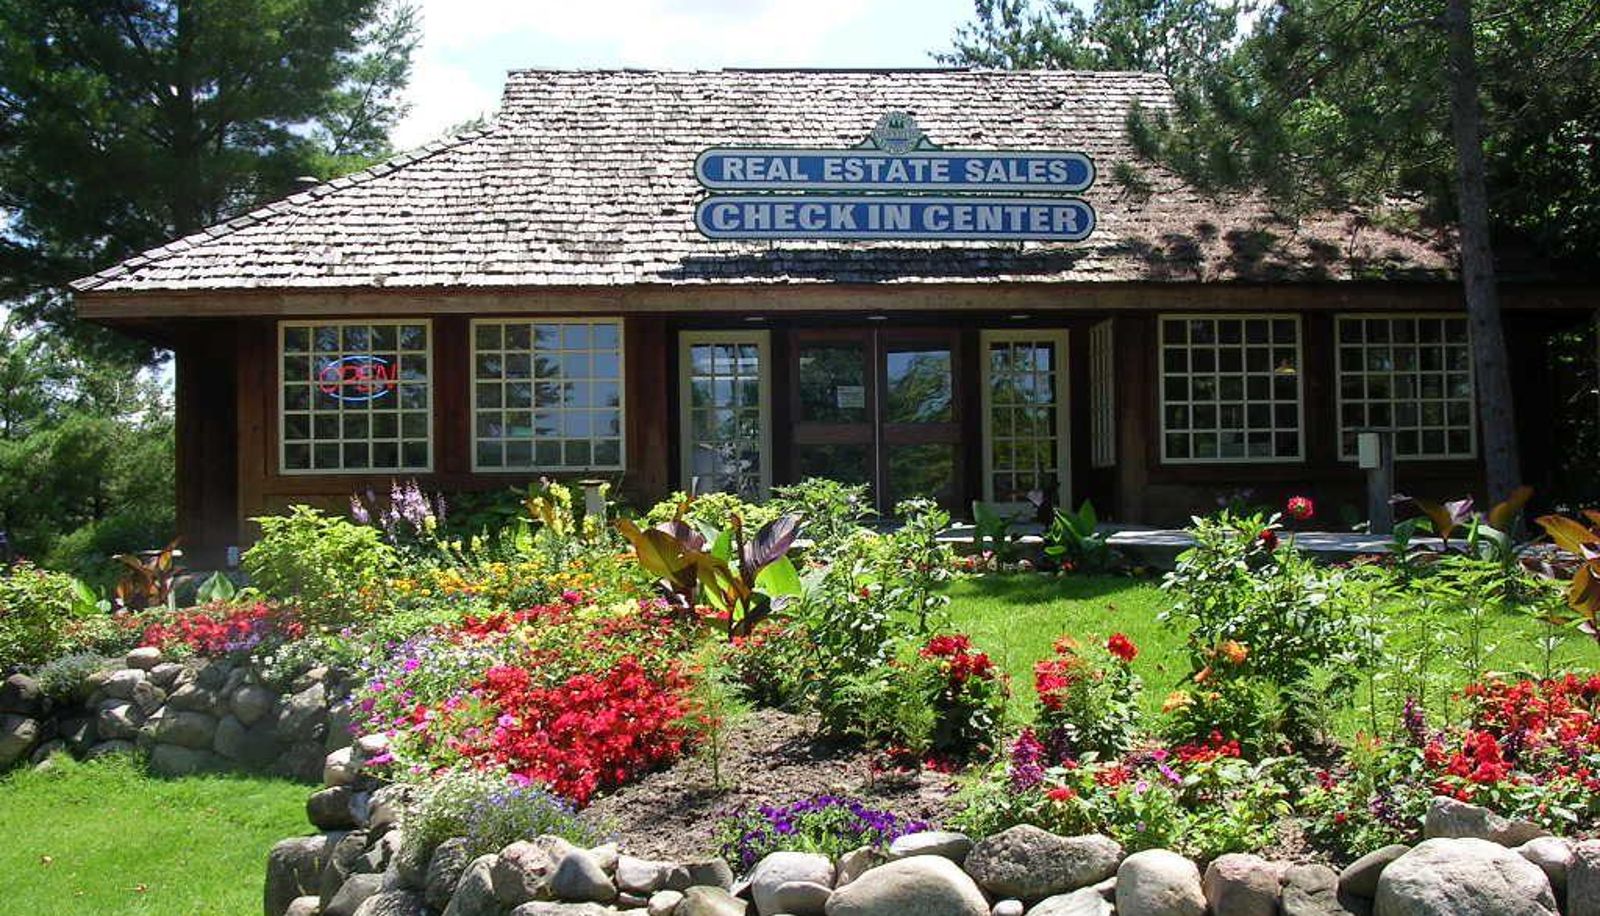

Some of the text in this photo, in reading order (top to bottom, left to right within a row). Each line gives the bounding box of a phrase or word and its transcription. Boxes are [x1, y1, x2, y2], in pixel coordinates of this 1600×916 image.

[722, 157, 1068, 184] REAL ESTATE SALES
[711, 203, 1079, 233] CHECK IN CENTER
[319, 362, 399, 394] OPEN
